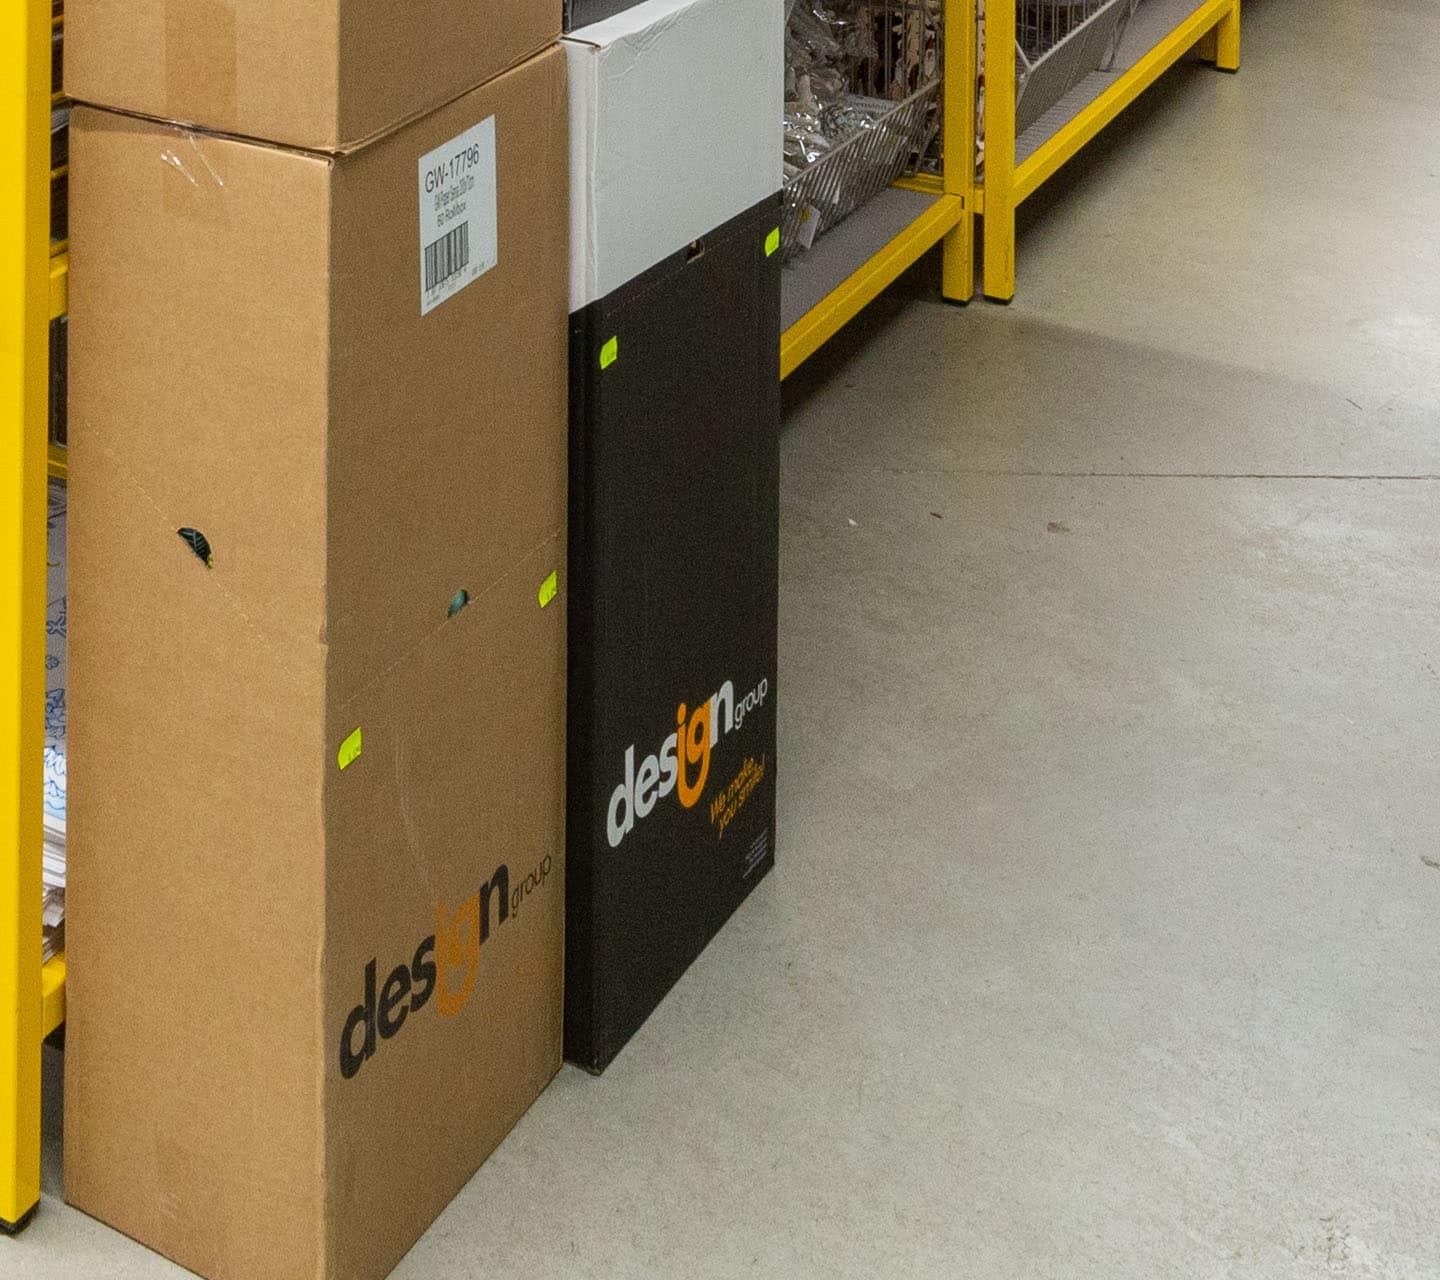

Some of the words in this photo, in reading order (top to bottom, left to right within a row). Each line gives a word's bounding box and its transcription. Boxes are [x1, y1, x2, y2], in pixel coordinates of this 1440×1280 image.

[425, 143, 480, 193] GW-17796
[606, 679, 732, 847] design
[734, 677, 769, 730] group
[338, 864, 509, 1079] design
[510, 853, 553, 917] group
